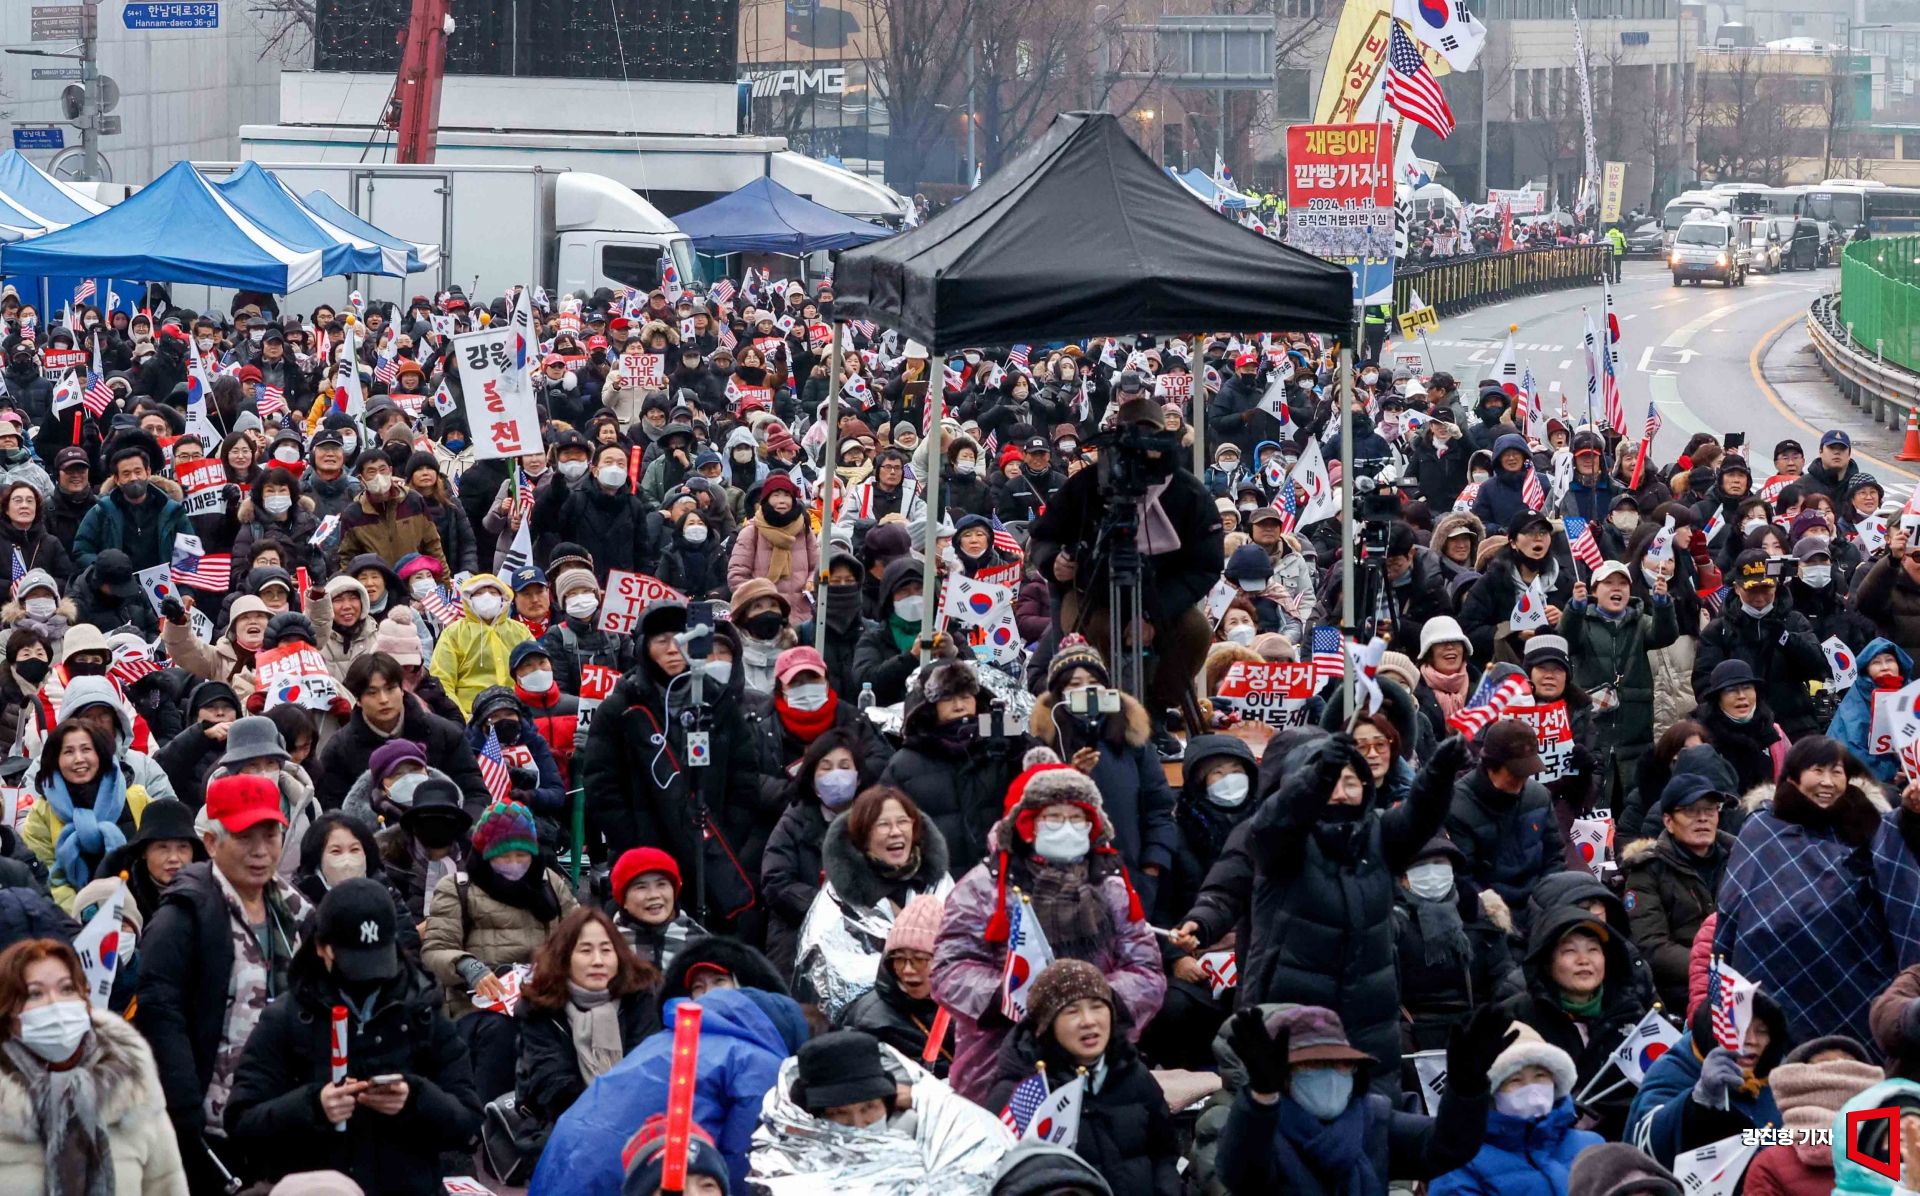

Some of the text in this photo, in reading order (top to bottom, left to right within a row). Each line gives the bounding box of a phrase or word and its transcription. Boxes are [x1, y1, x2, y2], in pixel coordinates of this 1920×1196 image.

[148, 4, 216, 18] 한남대로36길
[135, 19, 216, 28] Hannam-daero 36-gil
[1305, 129, 1375, 156] 재명아!
[1294, 163, 1388, 189] 깜빵가자!
[1298, 213, 1369, 226] 공직선거법위반
[1402, 309, 1436, 333] 구미
[624, 356, 659, 367] STOP
[629, 366, 655, 376] THE
[620, 376, 662, 387] STEAL
[1161, 376, 1194, 387] STOP
[1165, 386, 1190, 396] THE
[1227, 664, 1314, 691] 부정선거
[1246, 691, 1288, 708] OUT
